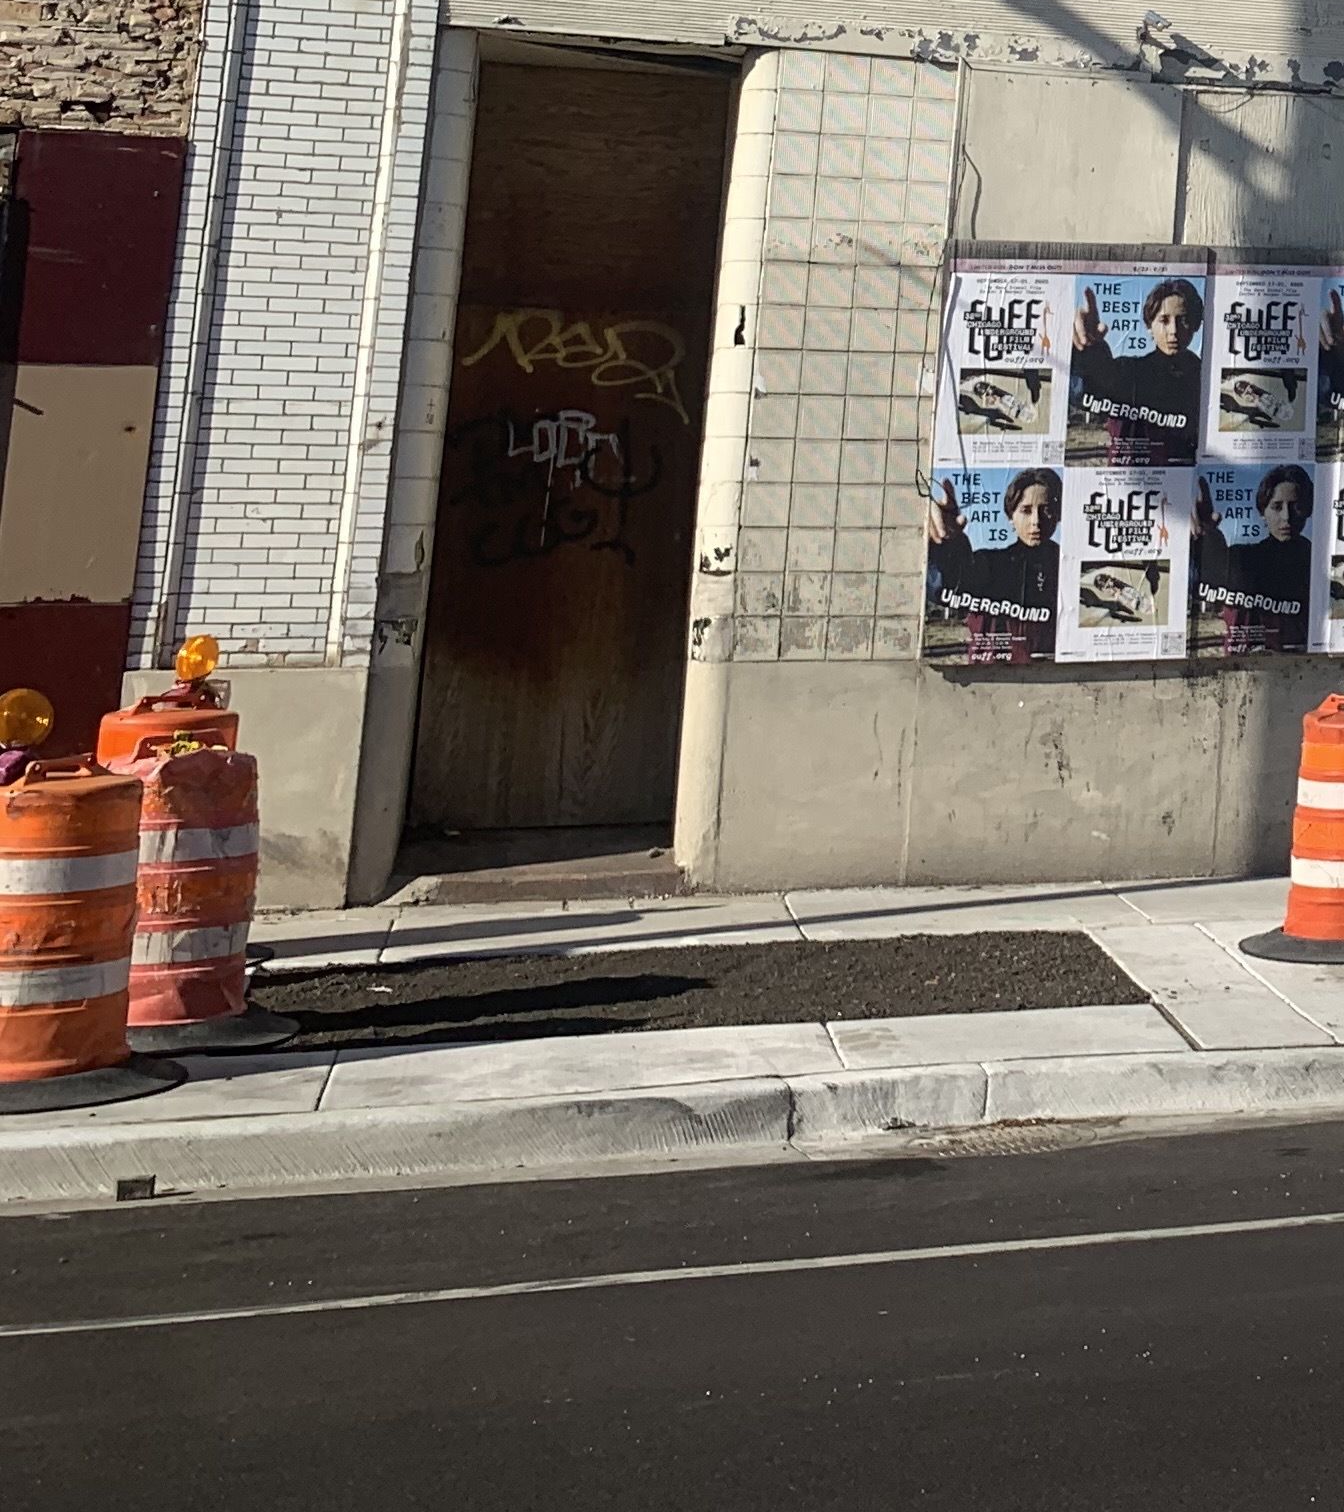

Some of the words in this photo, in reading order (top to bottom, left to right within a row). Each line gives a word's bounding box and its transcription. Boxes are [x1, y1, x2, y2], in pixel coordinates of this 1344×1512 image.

[1094, 283, 1121, 295] THE
[1102, 302, 1140, 313] BEST
[1111, 320, 1140, 331] ART
[1128, 337, 1146, 349] IS
[1083, 394, 1187, 428] UNDERGROUND
[1111, 456, 1150, 464] cuff.org
[953, 474, 981, 486] THE
[1207, 472, 1235, 483] THE
[962, 492, 1000, 504] BEST
[1216, 489, 1253, 501] BEST
[971, 511, 1000, 522] ART
[1225, 508, 1253, 519] ART
[989, 529, 1008, 541] IS
[1242, 525, 1260, 537] IS
[1112, 535, 1151, 543] FESTIVAL
[1199, 583, 1300, 614] UNDERGROUND
[941, 589, 1050, 622] UNDERGROUND
[971, 652, 1012, 661] cuff.org
